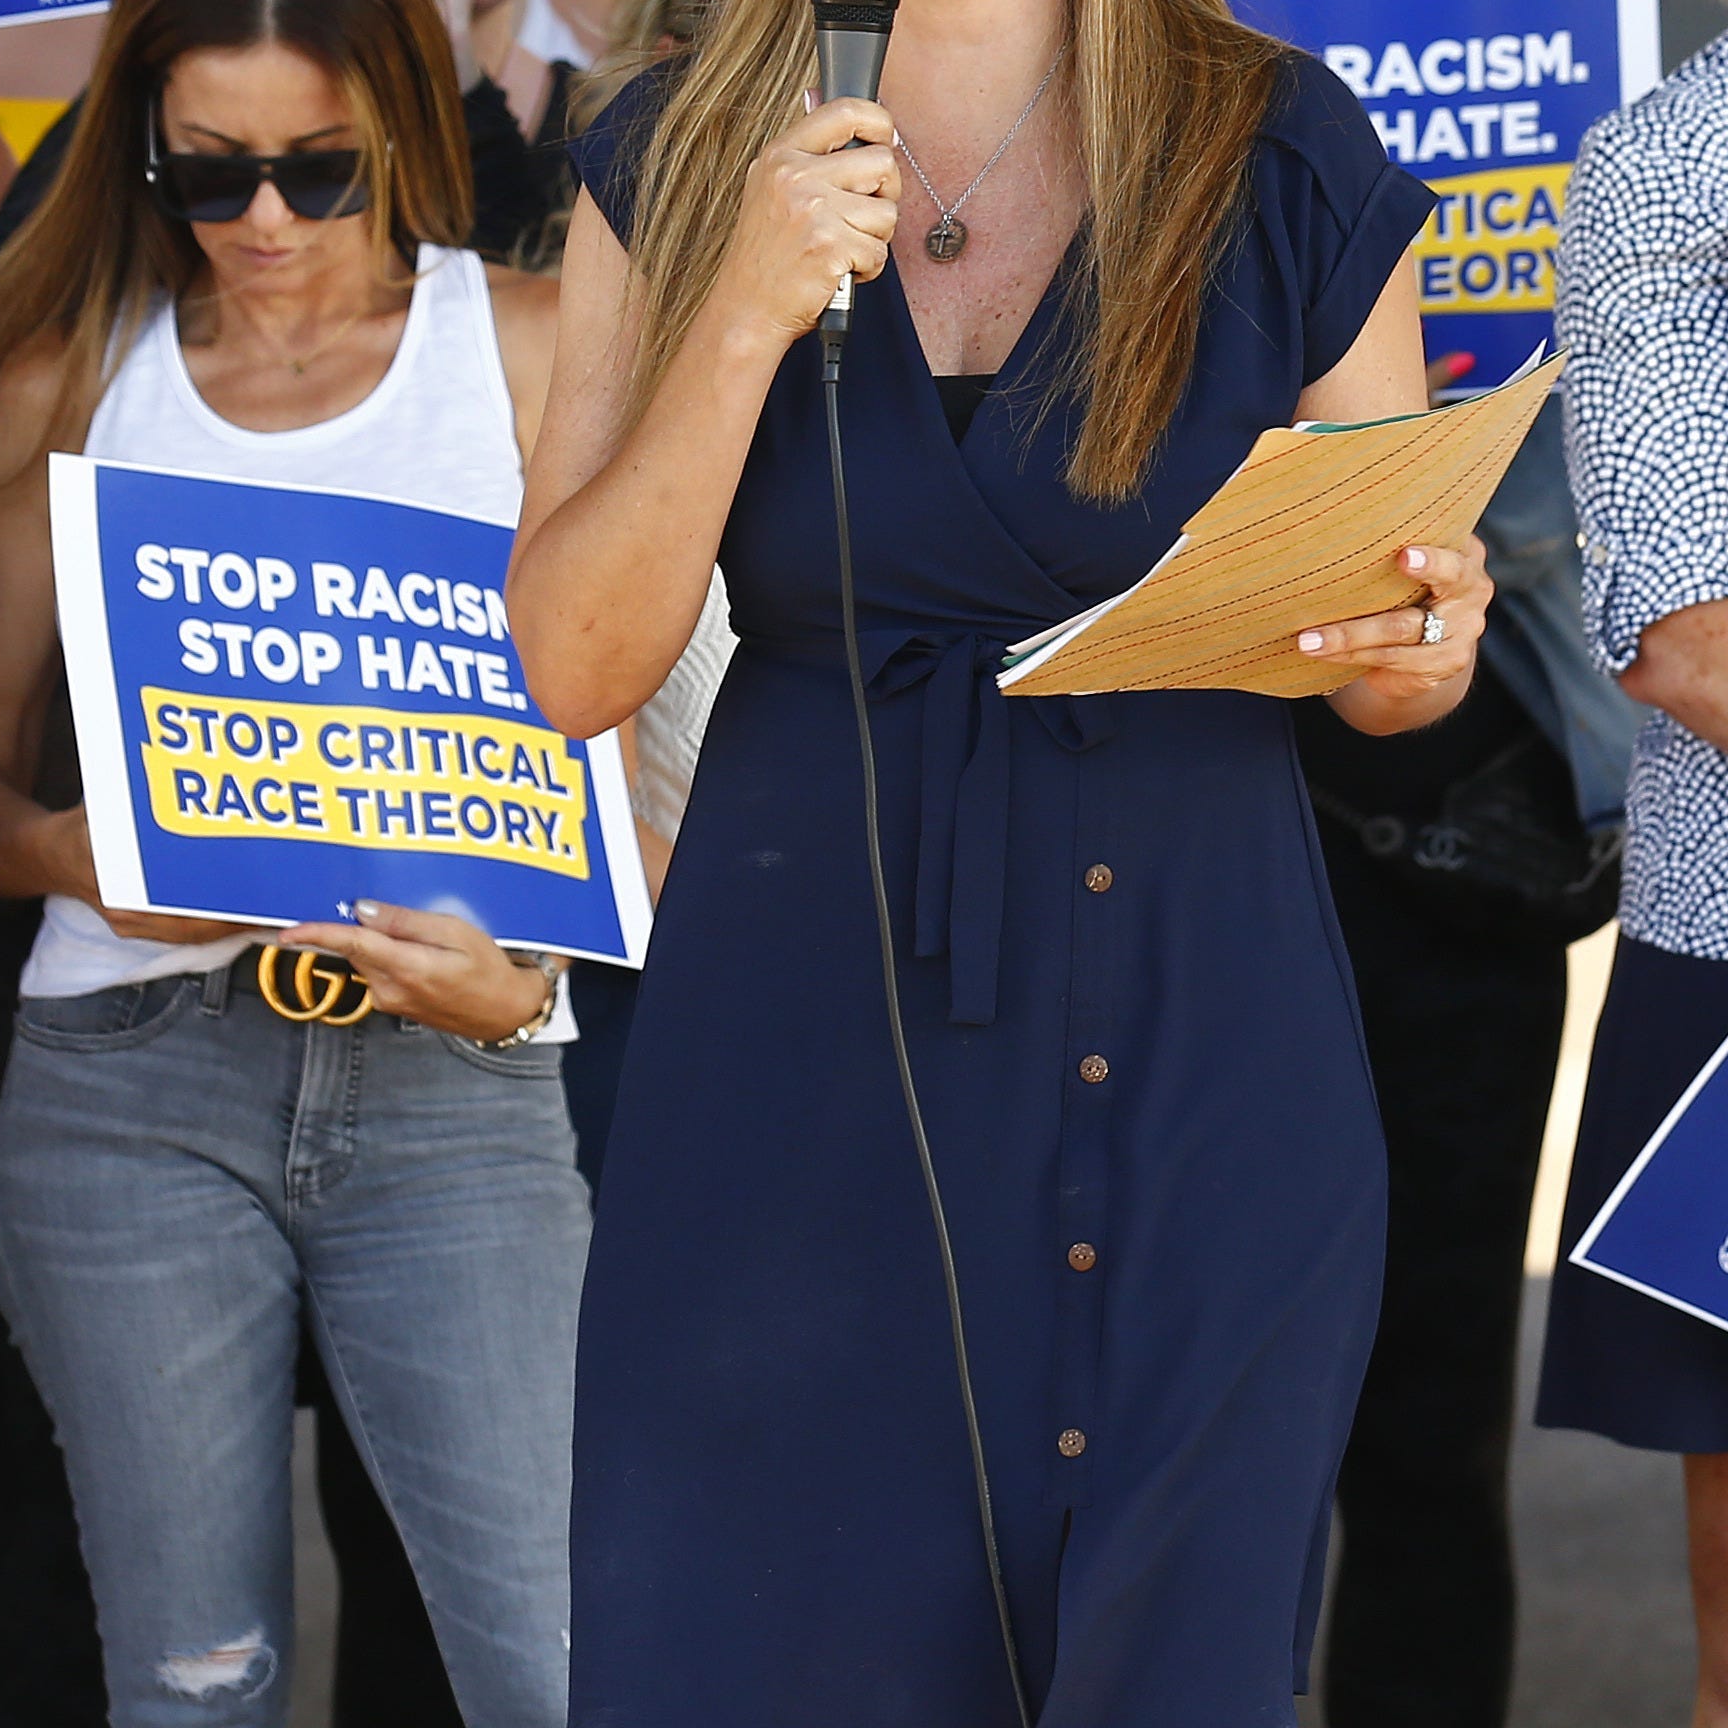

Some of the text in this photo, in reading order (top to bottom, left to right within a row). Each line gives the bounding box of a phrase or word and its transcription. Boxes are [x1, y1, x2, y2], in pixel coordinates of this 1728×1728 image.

[1323, 30, 1590, 99] RACISM.
[1369, 100, 1559, 163] HATE.
[135, 543, 299, 613] STOP
[178, 618, 529, 712] STOP HATE.
[156, 703, 571, 798] STOP CRITICAL
[173, 767, 576, 859] RACE THEORY.
